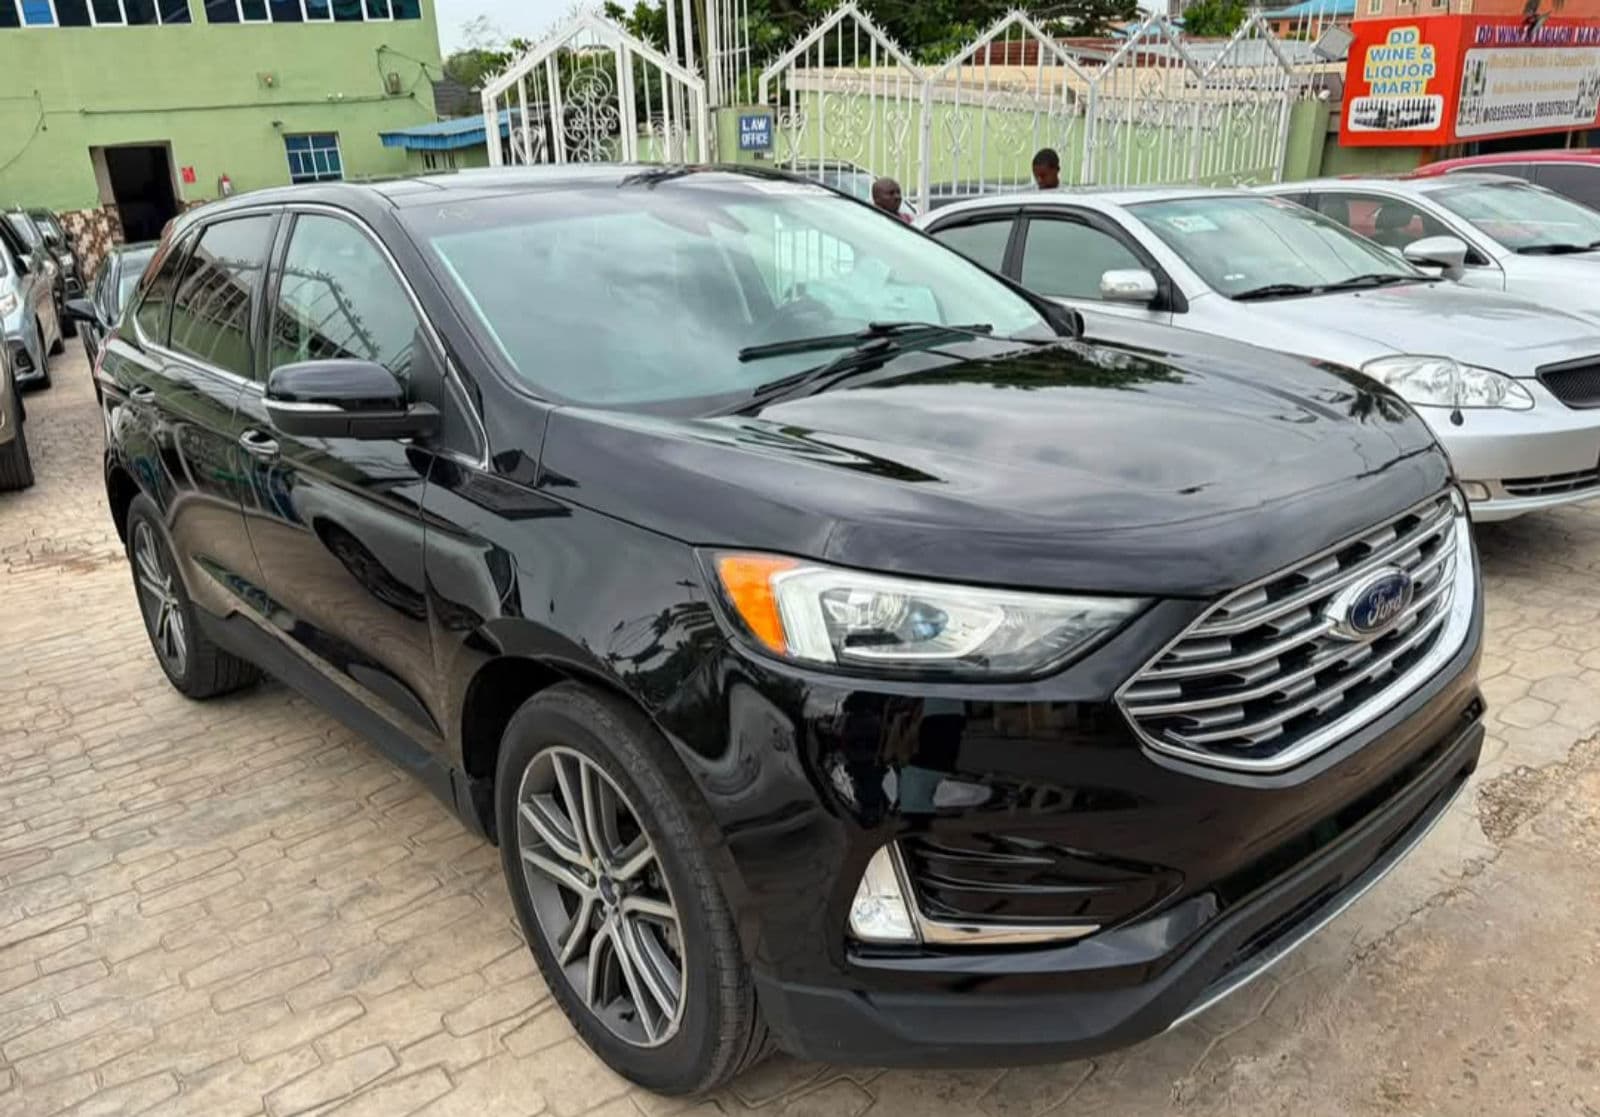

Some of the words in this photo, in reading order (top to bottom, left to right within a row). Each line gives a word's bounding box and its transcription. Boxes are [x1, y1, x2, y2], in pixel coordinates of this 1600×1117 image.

[1389, 30, 1415, 44] DD
[1573, 24, 1600, 42] MAR
[1370, 47, 1416, 62] WINE
[1421, 46, 1431, 59] &
[1365, 63, 1433, 79] LIQUOR
[1372, 80, 1423, 95] MART
[742, 117, 768, 131] LAW
[742, 132, 768, 147] OFFICE
[1367, 584, 1403, 627] Ford
